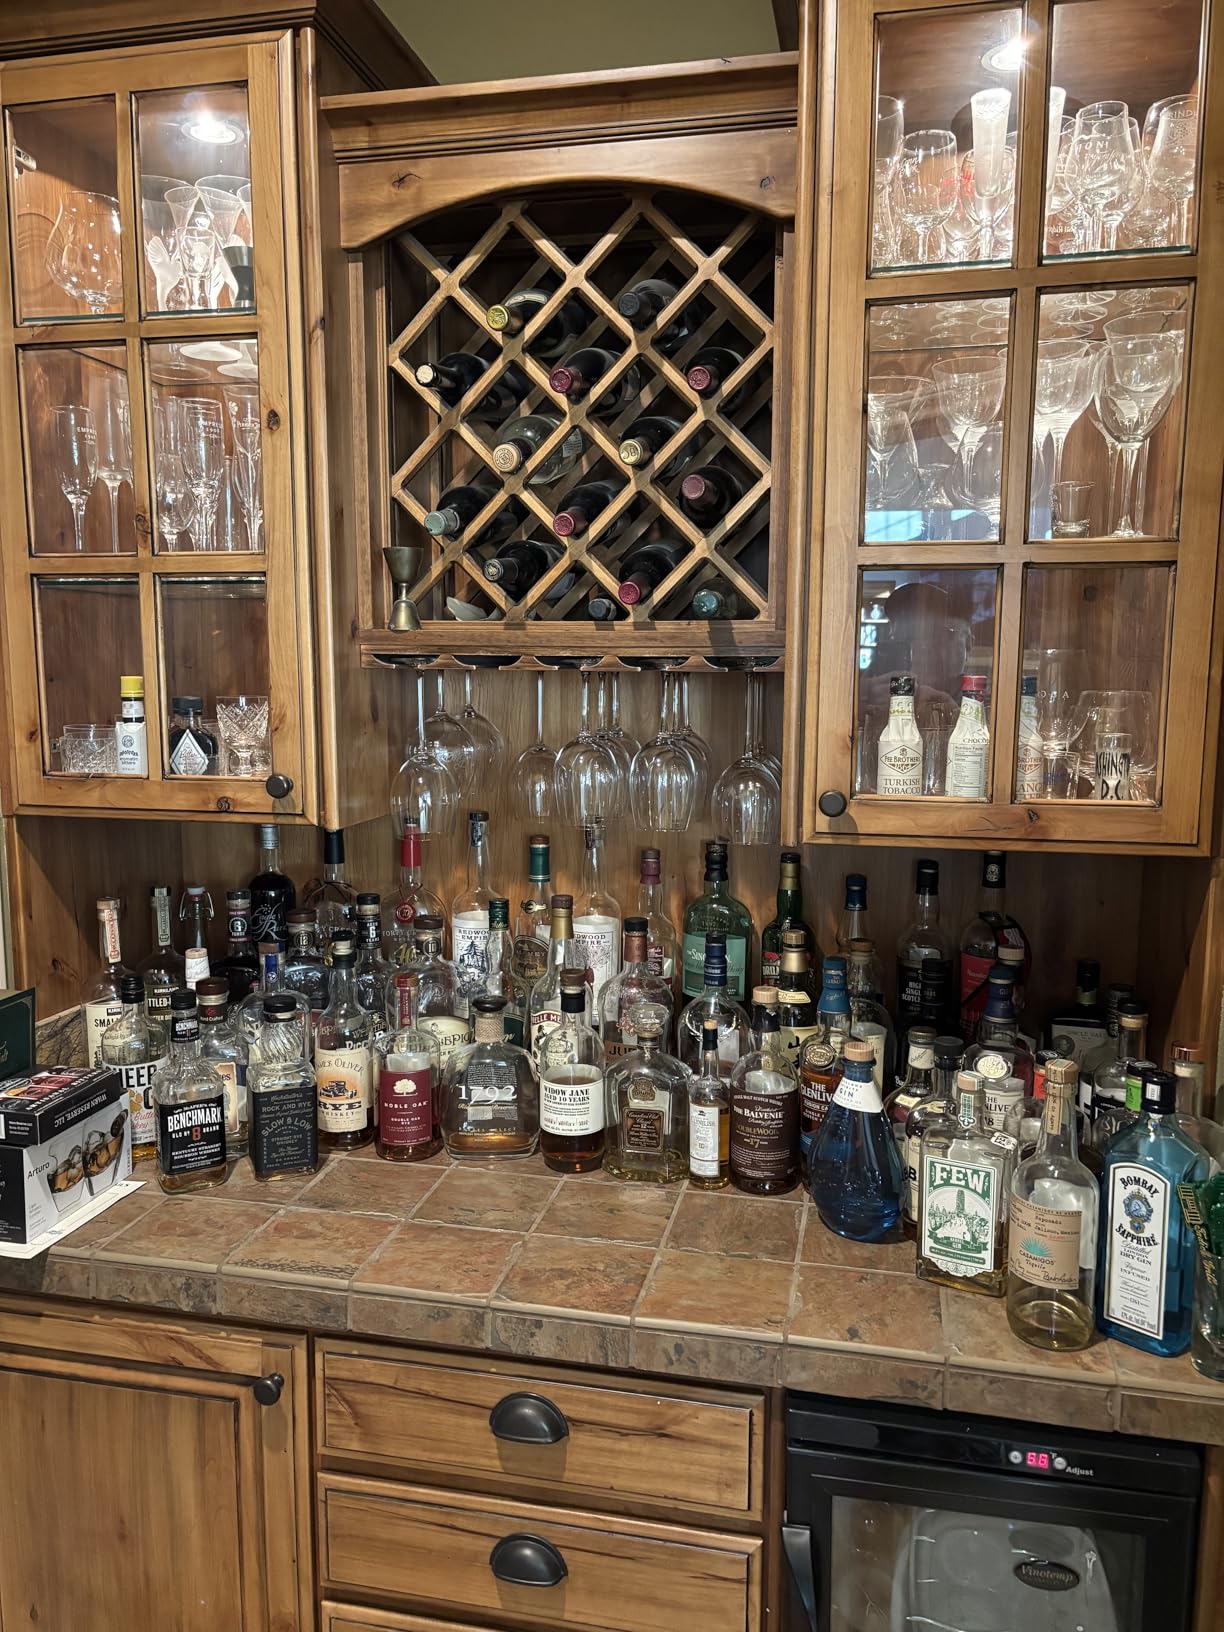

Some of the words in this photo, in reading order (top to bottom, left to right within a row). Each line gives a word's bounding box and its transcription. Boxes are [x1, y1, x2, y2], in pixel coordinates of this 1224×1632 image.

[884, 778, 920, 786] TURKISH
[883, 787, 921, 795] TOBACCO
[369, 926, 376, 938] 6
[543, 1084, 567, 1096] WIDOW
[568, 1087, 590, 1097] JANE
[811, 1081, 827, 1092] THE
[839, 1087, 854, 1098] GIN
[456, 1083, 517, 1105] 1792
[800, 1083, 833, 1103] GLENLIV
[261, 1105, 280, 1113] ROCK
[282, 1103, 296, 1111] AND
[318, 1100, 362, 1111] RYE
[412, 1100, 428, 1108] OAK
[167, 1106, 223, 1132] BENCHMARK
[744, 1108, 784, 1119] BALVENIE
[54, 1117, 65, 1128] LLC
[261, 1117, 285, 1137] SLOW
[294, 1117, 313, 1130] LOW
[191, 1126, 201, 1141] 8
[749, 1137, 760, 1148] 17
[27, 1161, 50, 1180] Arturo
[1119, 1175, 1160, 1198] BOMBAY
[1115, 1222, 1158, 1247] SAPPHIRE
[1019, 1249, 1056, 1266] CASAMIGOS
[1119, 1250, 1137, 1261] DRY
[1136, 1256, 1152, 1266] GIN
[1065, 1466, 1094, 1477] Adjust
[1021, 1564, 1074, 1583] Vinotemp
